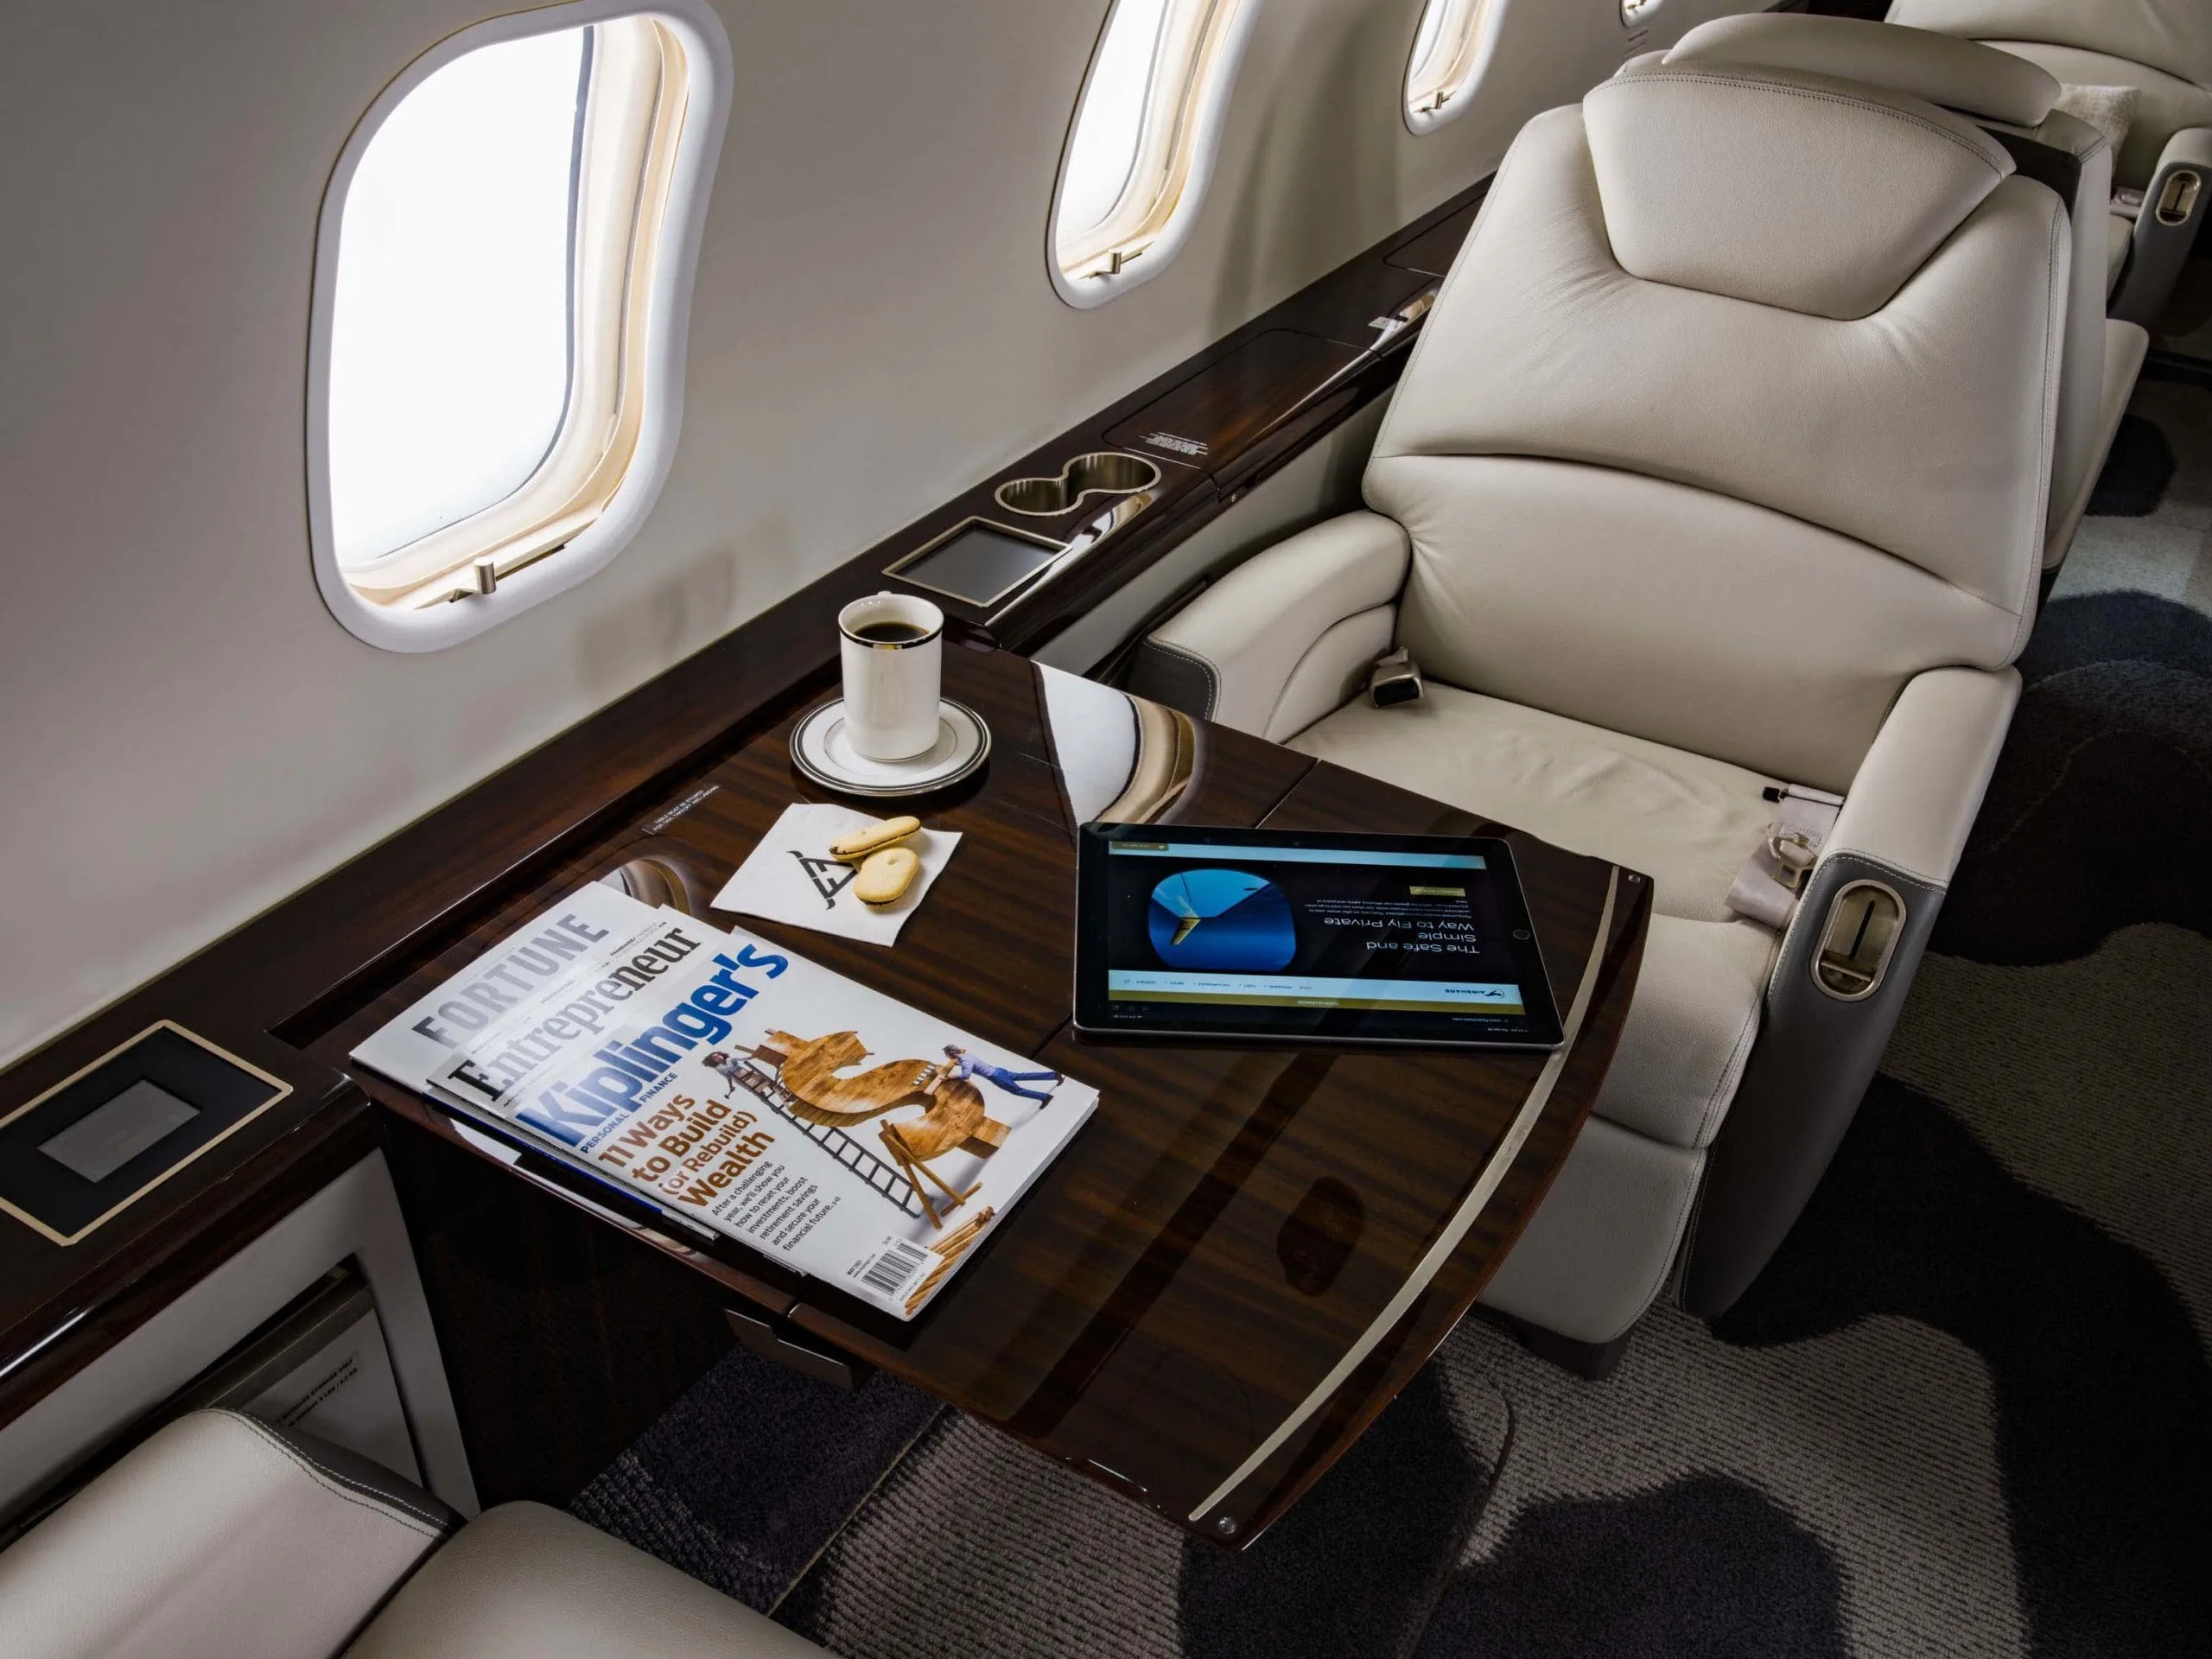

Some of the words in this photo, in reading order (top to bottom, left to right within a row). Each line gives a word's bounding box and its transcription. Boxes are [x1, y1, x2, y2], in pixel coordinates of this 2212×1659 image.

[1324, 918, 1382, 927] Private
[1366, 941, 1398, 950] and
[1388, 918, 1412, 929] Fly
[1403, 944, 1442, 952] Safe
[1418, 931, 1476, 942] Simple
[1438, 921, 1474, 931] Way
[1446, 944, 1479, 954] The
[411, 914, 609, 1049] FORTUNE
[448, 926, 701, 1102] Entrepreneur
[515, 944, 789, 1147] Kiplinger's
[580, 1113, 629, 1154] PERSONAL
[642, 1072, 677, 1103] FINANCE
[599, 1145, 635, 1167] 11
[620, 1094, 696, 1147] Ways
[632, 1156, 671, 1182] to
[658, 1100, 732, 1156] Build
[658, 1171, 690, 1195] (or
[682, 1111, 758, 1172] Rebuild)
[677, 1132, 775, 1206] Wealth
[712, 1198, 731, 1216] After
[734, 1161, 772, 1195] challenging
[723, 1207, 743, 1222] year,
[740, 1192, 758, 1206] we'll
[754, 1176, 773, 1193] show
[771, 1165, 785, 1178] you
[734, 1212, 753, 1228] how
[758, 1190, 777, 1206] reset
[775, 1177, 790, 1192] your
[747, 1194, 791, 1235] investments,
[785, 1177, 808, 1195] boost
[760, 1206, 793, 1240] retirement
[792, 1185, 817, 1207] savings
[772, 1230, 787, 1246] and
[785, 1212, 807, 1232] secure
[804, 1198, 820, 1214] your
[782, 1224, 813, 1251] financial
[809, 1205, 834, 1224] future.
